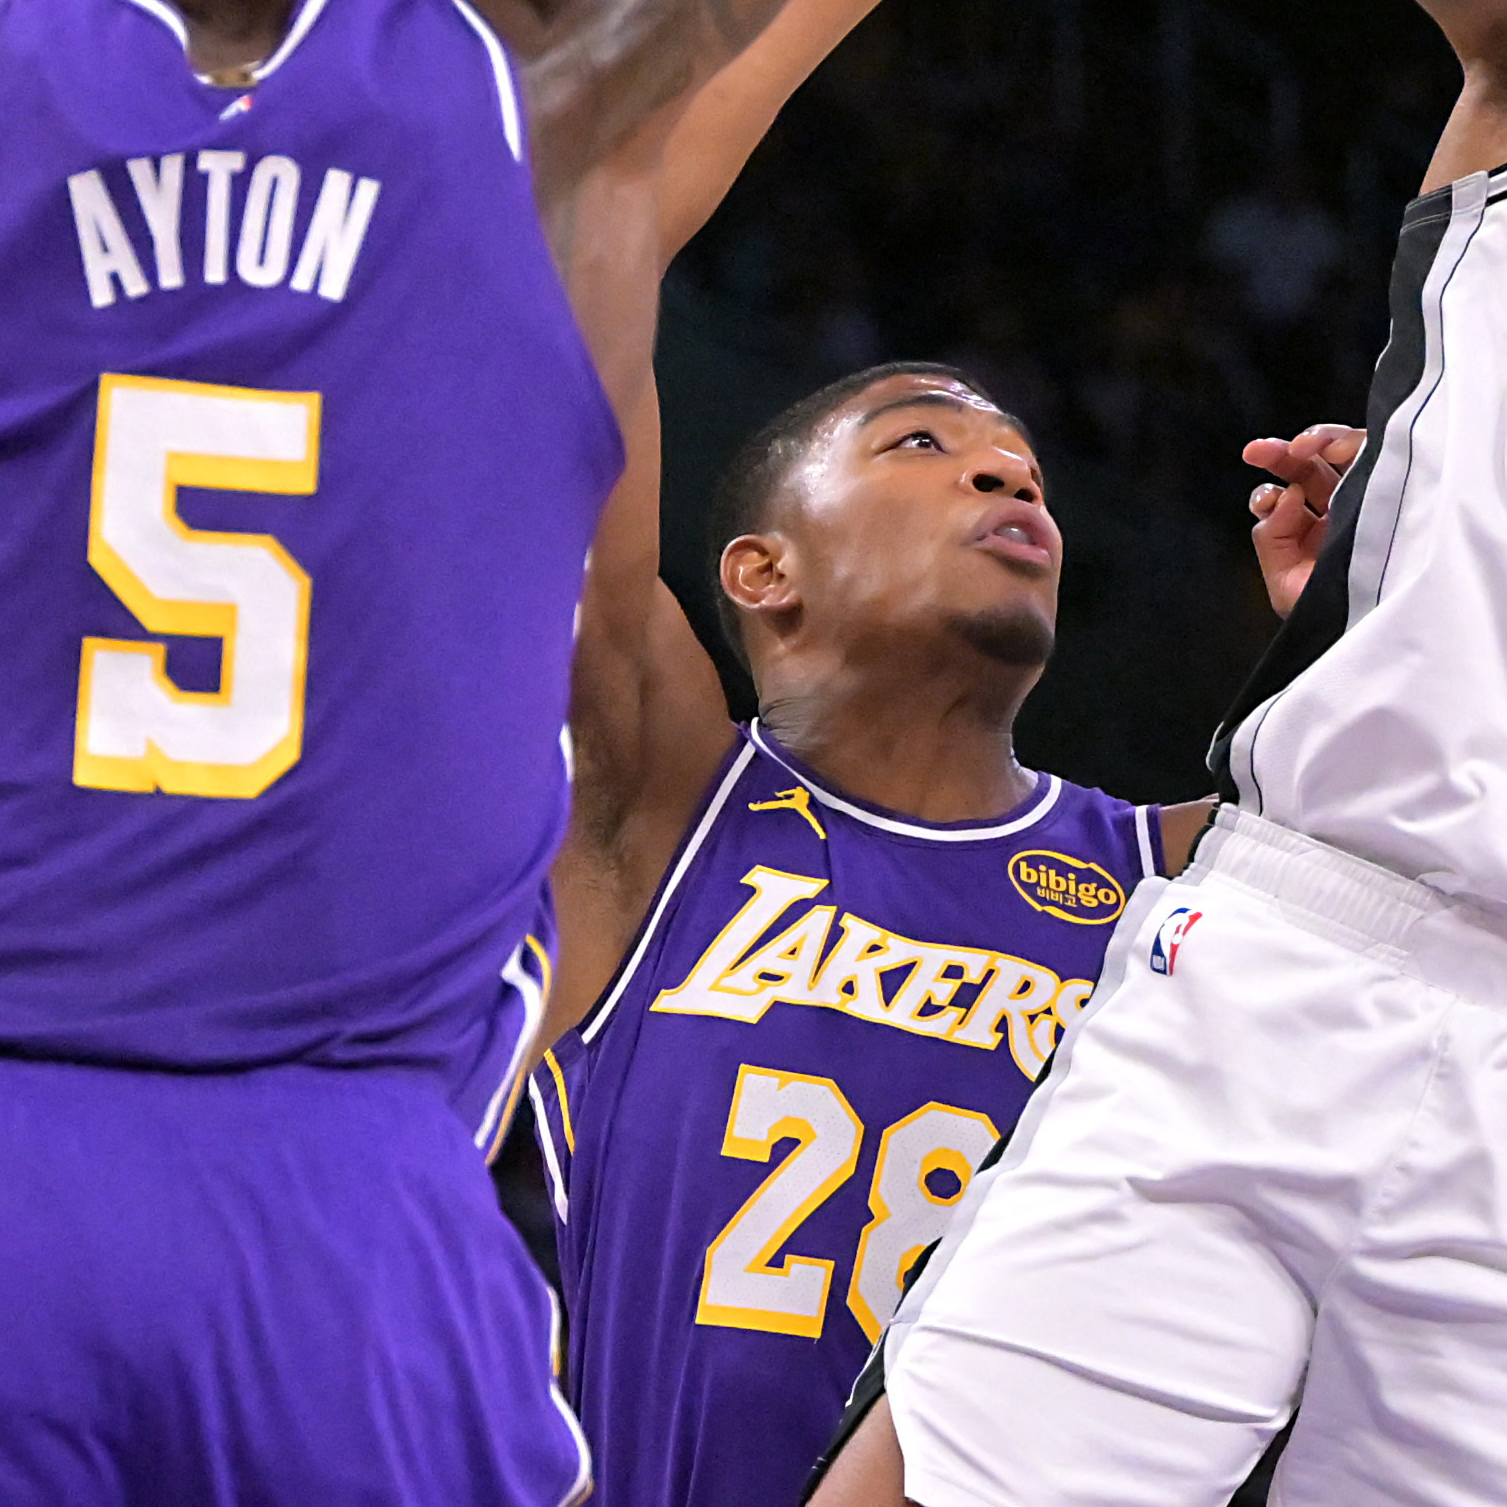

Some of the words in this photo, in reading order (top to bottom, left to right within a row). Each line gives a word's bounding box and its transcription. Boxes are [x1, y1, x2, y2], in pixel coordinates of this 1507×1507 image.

[67, 149, 382, 309] AYTON
[72, 372, 323, 800] 5
[1019, 860, 1118, 908] bibigo
[1036, 885, 1078, 908] 비비고
[694, 1063, 1002, 1346] 28
